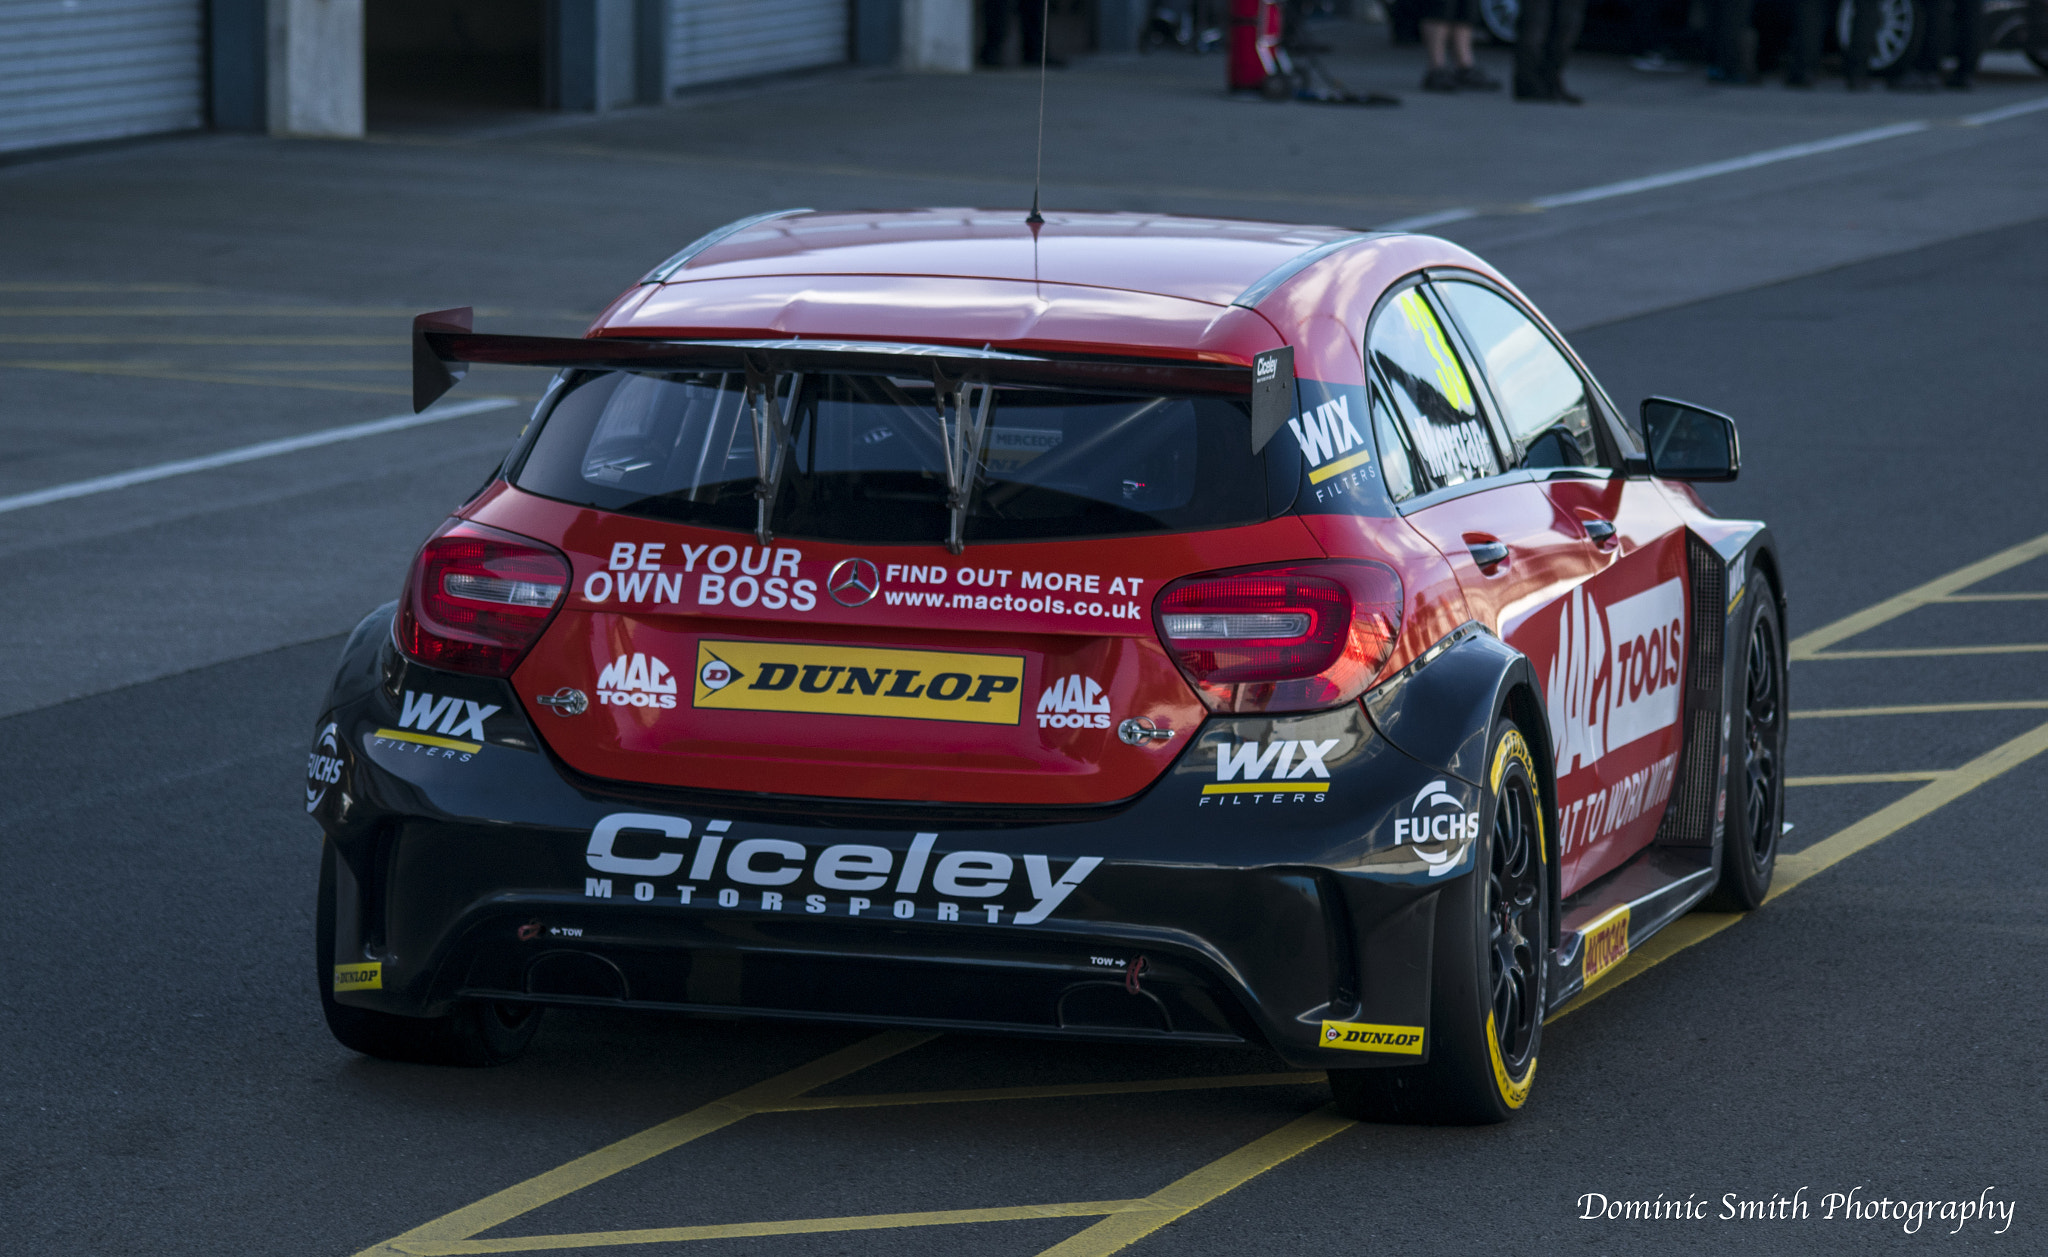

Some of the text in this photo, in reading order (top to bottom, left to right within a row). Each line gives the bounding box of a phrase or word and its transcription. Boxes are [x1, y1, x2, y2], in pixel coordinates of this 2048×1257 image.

[1257, 355, 1278, 379] Ciceley
[1400, 293, 1472, 410] 33
[1288, 395, 1363, 467] WIX
[1315, 465, 1377, 503] FILTERS
[608, 542, 803, 578] BE YOUR
[583, 572, 817, 612] OWN BOSS
[885, 564, 1144, 598] FIND OUT MORE AT
[885, 590, 1142, 620] www.mactools.co.uk
[597, 652, 677, 694] MAC
[748, 662, 1020, 703] DUNLOP
[1547, 583, 1682, 779] MAC TOOLS
[596, 690, 678, 709] TOOLS
[1037, 674, 1111, 713] MAC
[398, 690, 502, 741] WIX
[1036, 711, 1111, 729] TOOLS
[374, 738, 472, 763] FILTERS
[1217, 738, 1340, 781] WIX
[1199, 793, 1326, 807] FILTERS
[1580, 788, 1610, 847] TO
[1602, 768, 1648, 836] WORK
[1394, 812, 1480, 846] FUCHS
[586, 812, 1104, 926] Ciceley
[585, 877, 1005, 924] MOTORSPORT
[562, 927, 583, 937] TOW
[340, 970, 378, 984] DUNLOP
[1090, 956, 1114, 967] TOW
[1342, 1030, 1420, 1047] DUNLOP
